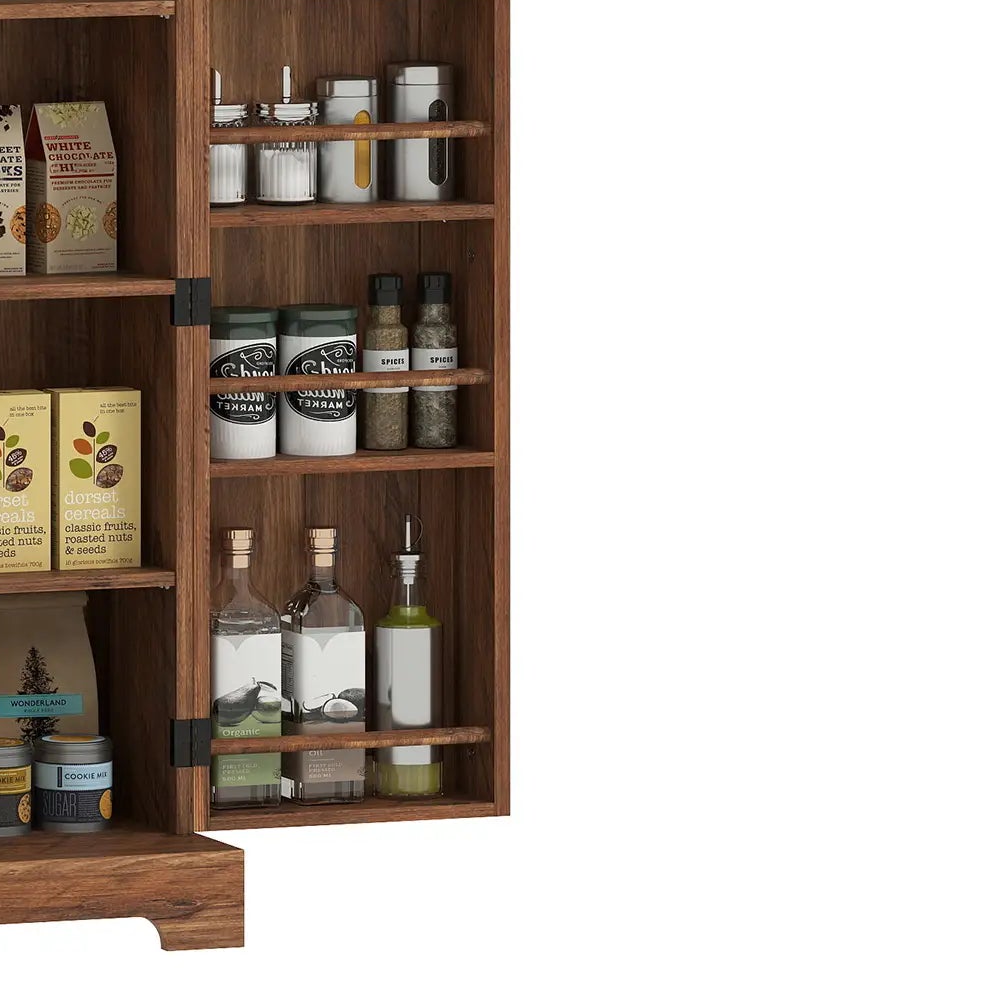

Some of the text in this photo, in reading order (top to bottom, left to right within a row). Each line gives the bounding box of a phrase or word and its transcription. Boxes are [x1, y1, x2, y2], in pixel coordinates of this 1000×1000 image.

[46, 141, 91, 151] WHITE
[430, 356, 454, 364] SPICES
[65, 488, 119, 505] dorset
[65, 504, 126, 521] cereals
[13, 525, 46, 535] fruits,
[65, 521, 137, 533] classic fruits,
[18, 537, 43, 546] nuts
[65, 533, 133, 544] roasted nuts
[65, 545, 107, 555] & seeds
[11, 699, 67, 707] WONDERLAND
[222, 728, 260, 738] Organic
[64, 772, 96, 780] COOKIE
[42, 791, 77, 817] SUGAR
